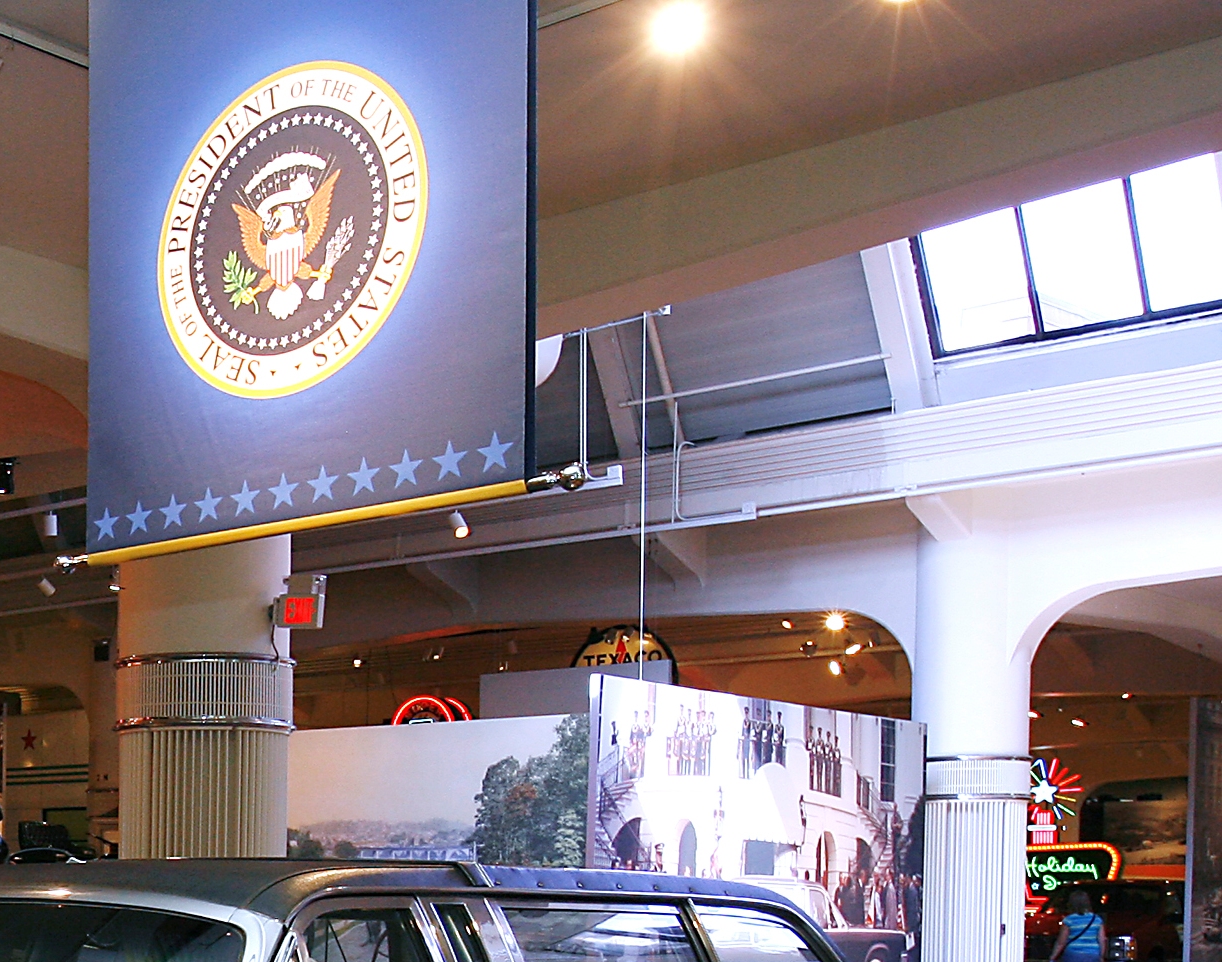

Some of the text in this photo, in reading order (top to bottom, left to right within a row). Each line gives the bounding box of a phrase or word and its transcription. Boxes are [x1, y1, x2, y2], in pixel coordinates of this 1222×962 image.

[168, 78, 416, 386] SEAL OF THE PRESIDENT OF THE UNITED STATES
[1025, 856, 1098, 880] Holiday
